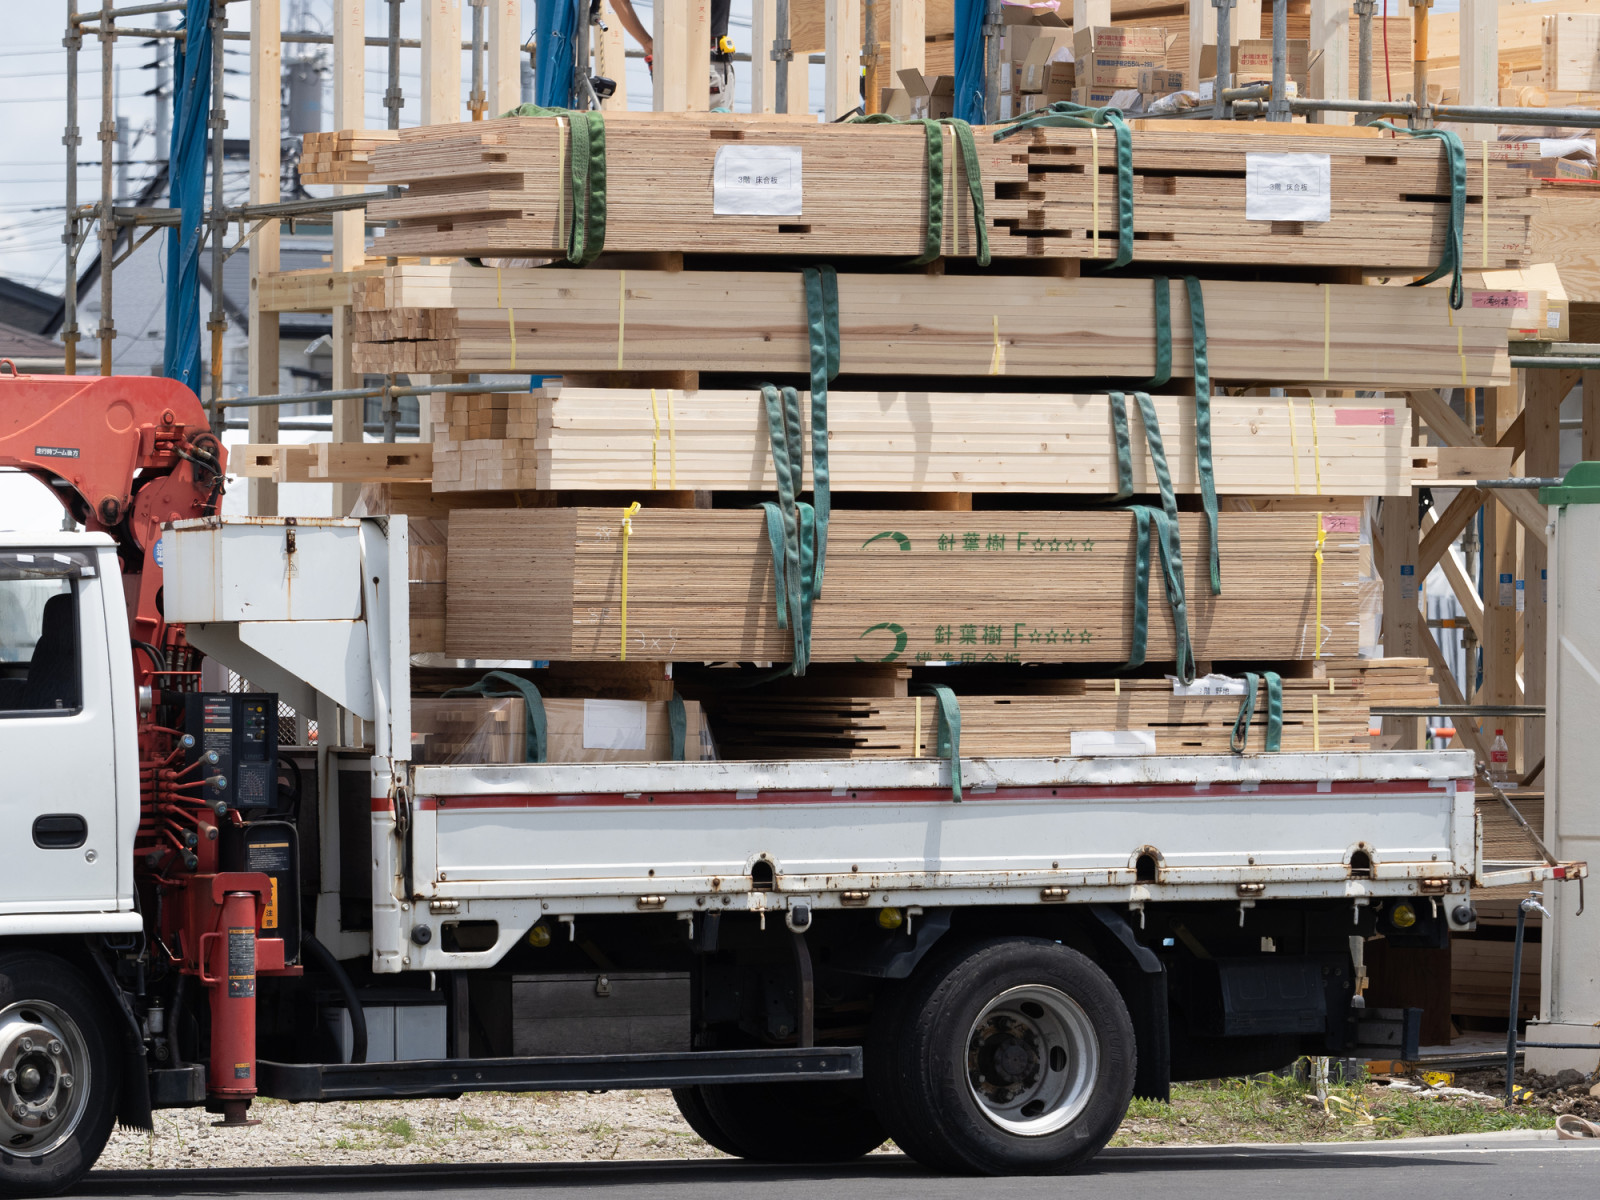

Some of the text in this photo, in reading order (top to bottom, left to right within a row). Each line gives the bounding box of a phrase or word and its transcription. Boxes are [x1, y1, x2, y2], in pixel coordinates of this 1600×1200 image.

[738, 176, 778, 185] 3階 床合板
[937, 532, 1006, 551] 針葉樹
[935, 624, 1002, 645] 針葉樹
